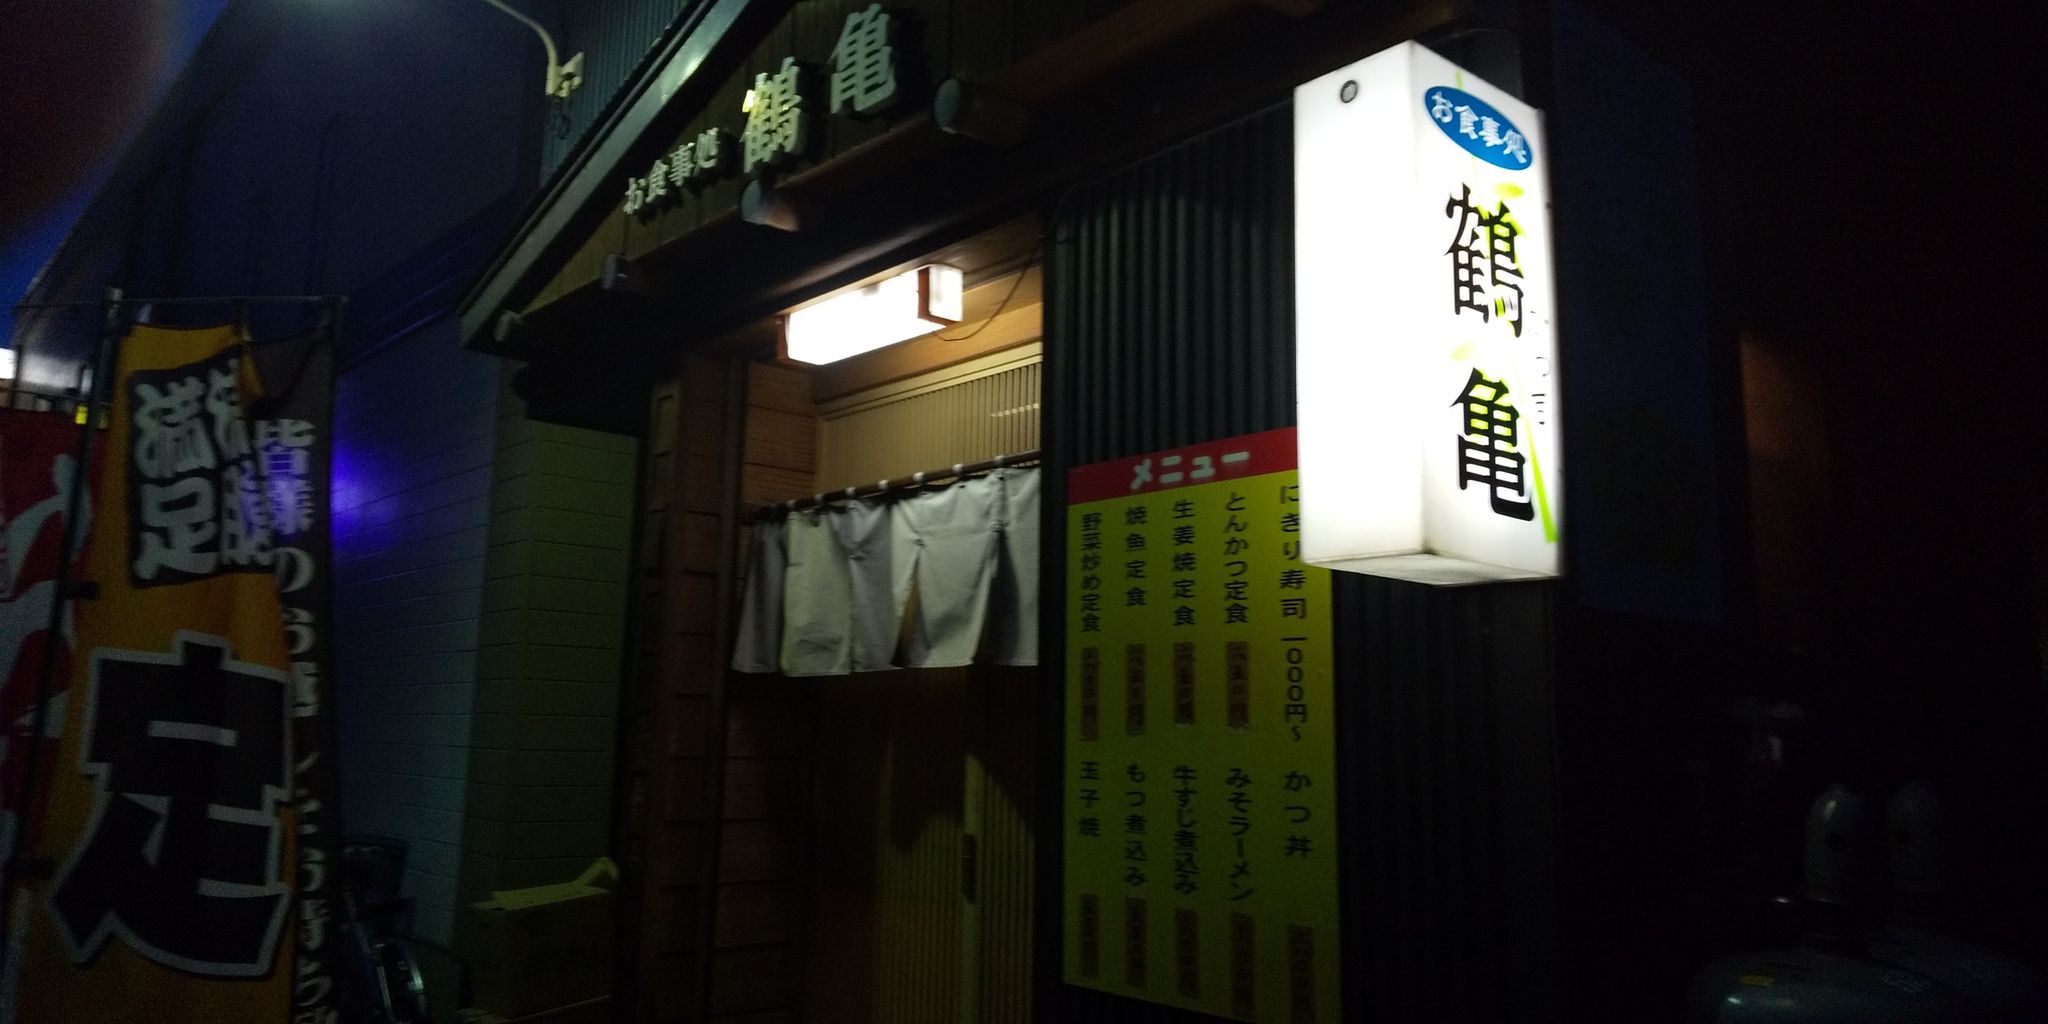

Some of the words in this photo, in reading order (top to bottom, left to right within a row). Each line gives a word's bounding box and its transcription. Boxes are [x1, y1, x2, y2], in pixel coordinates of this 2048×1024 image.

[623, 127, 719, 215] お食事処
[1431, 91, 1527, 163] お食事処
[1444, 182, 1534, 521] 鶴亀
[1129, 450, 1251, 491] メニュー
[1081, 512, 1101, 633] 野菜炒め定食
[1125, 506, 1149, 607] 焼魚定食
[1172, 500, 1197, 626] 生姜焼定食
[1224, 492, 1249, 624] とんかつ定食
[1124, 762, 1148, 886] もつ煮込み
[1173, 764, 1200, 895] 牛すじ煮込み
[1225, 767, 1255, 901] みそラーメン
[1284, 770, 1312, 858] かつ丼
